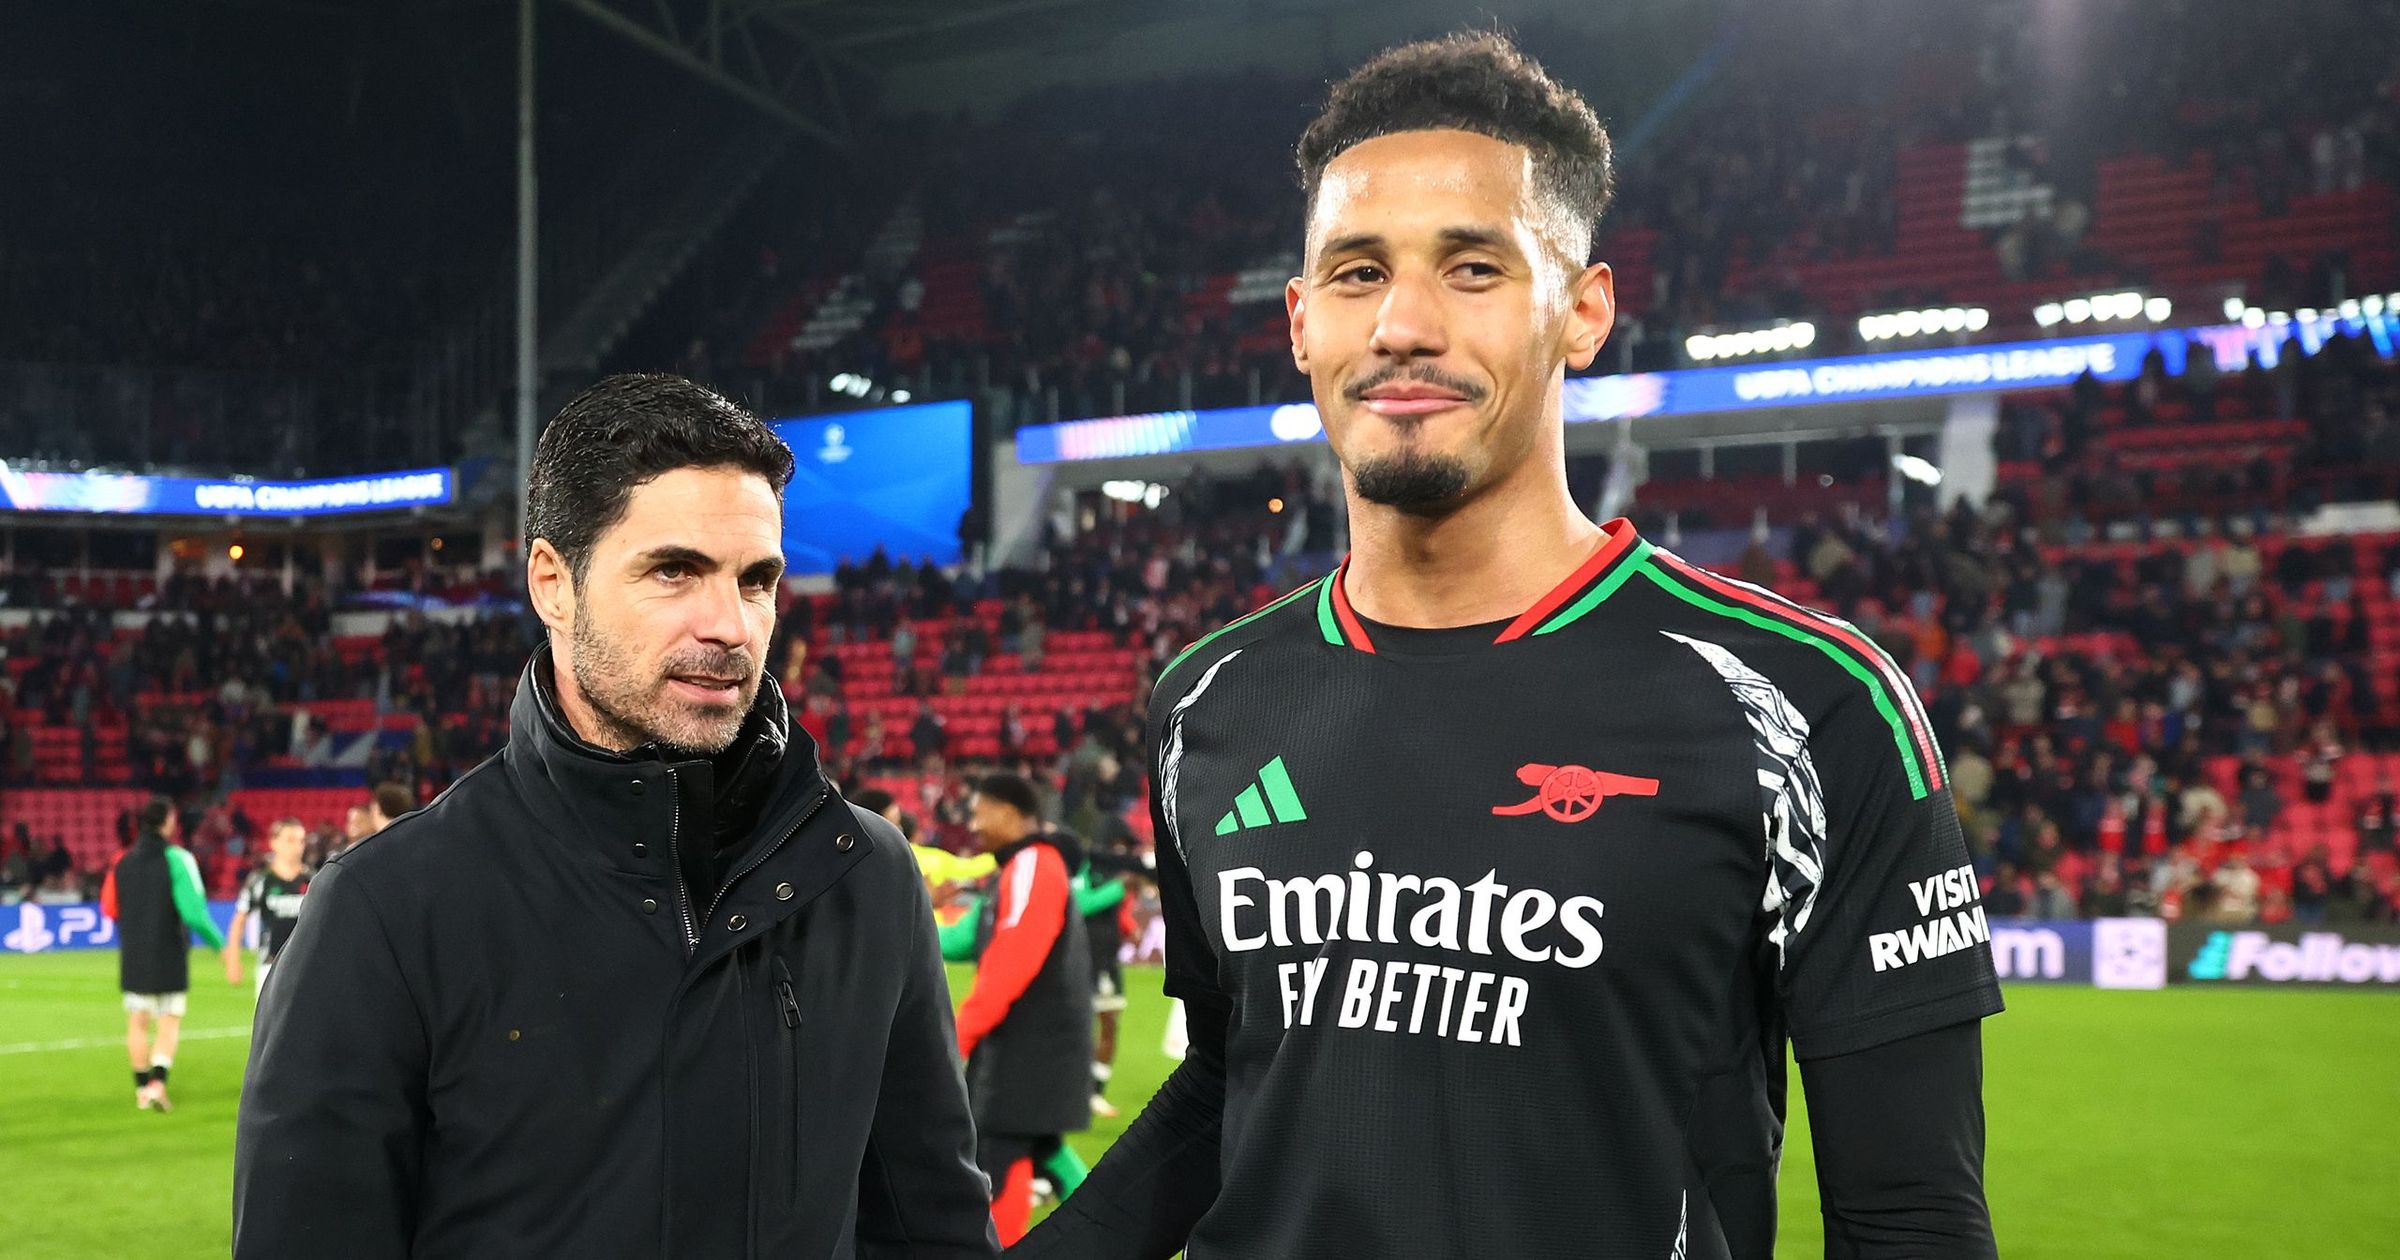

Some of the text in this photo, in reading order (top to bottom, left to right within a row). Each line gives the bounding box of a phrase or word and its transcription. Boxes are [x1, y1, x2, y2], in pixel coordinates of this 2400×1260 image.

[1217, 850, 1605, 969] Emirates
[1907, 863, 1981, 917] VISIT
[1868, 904, 1991, 972] RWAN
[1337, 958, 1530, 1047] BETTER
